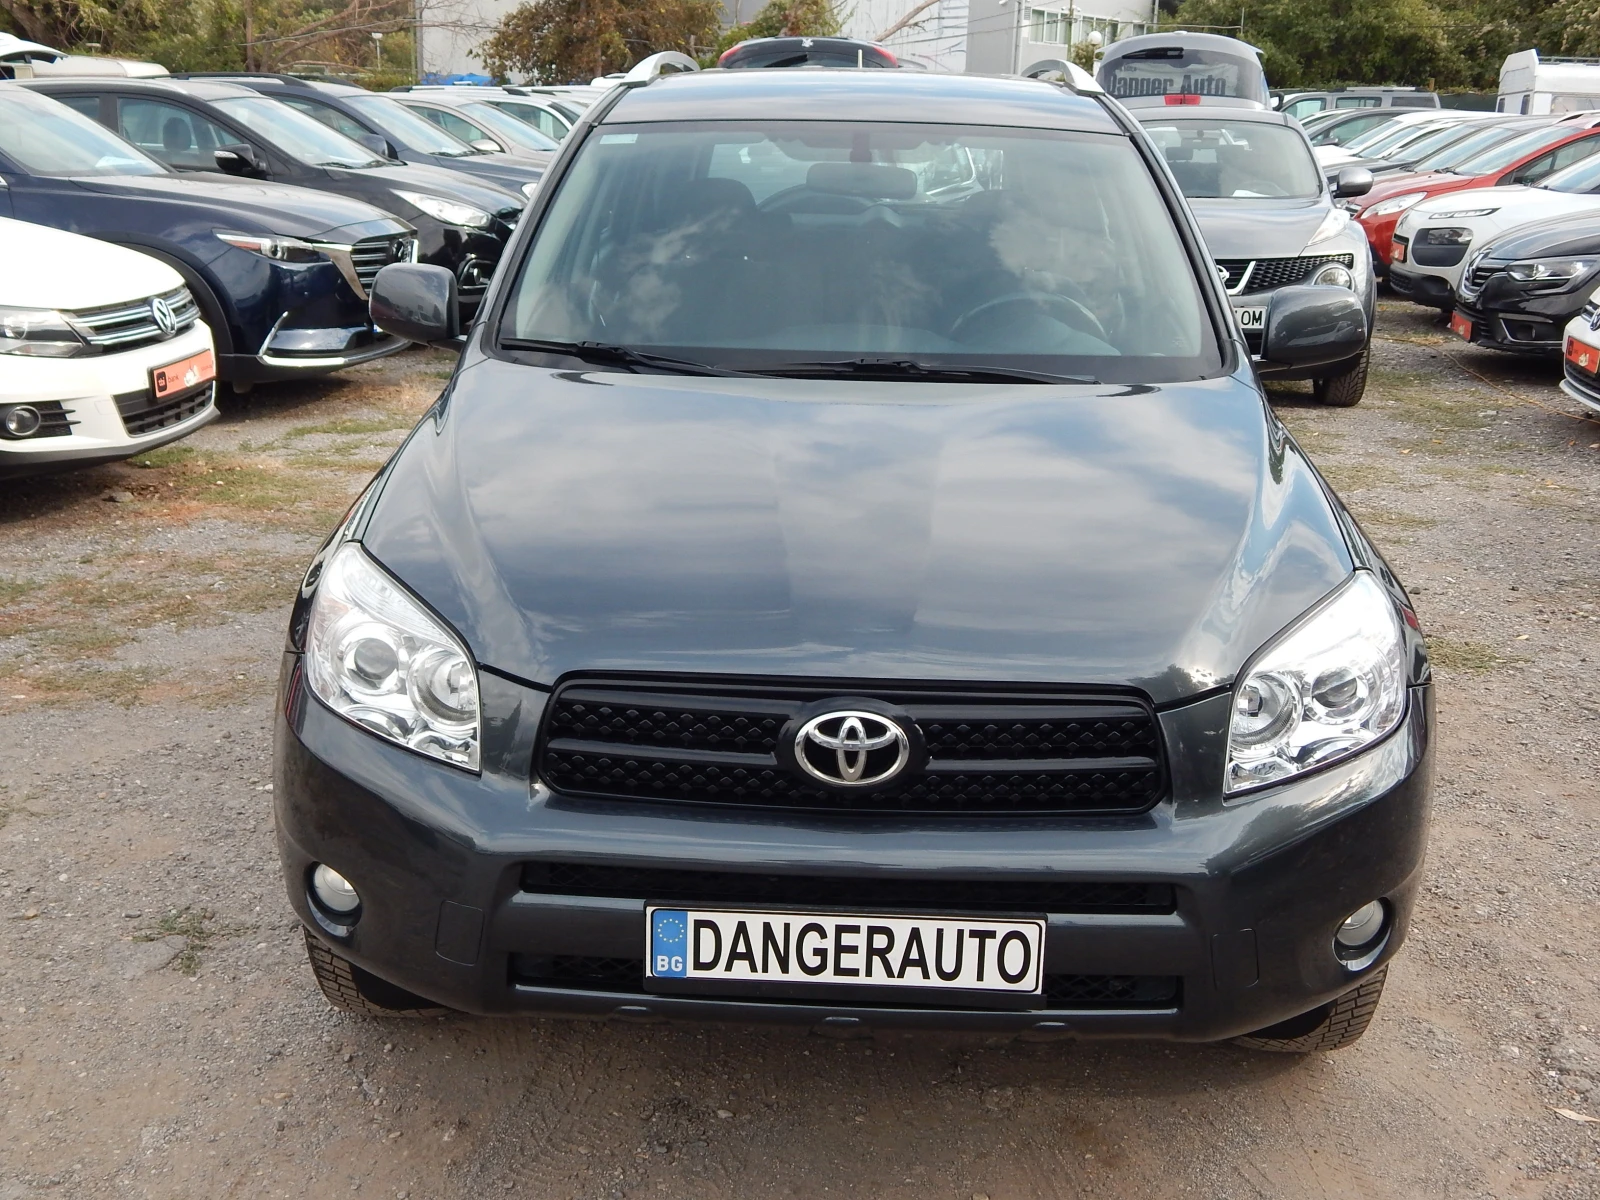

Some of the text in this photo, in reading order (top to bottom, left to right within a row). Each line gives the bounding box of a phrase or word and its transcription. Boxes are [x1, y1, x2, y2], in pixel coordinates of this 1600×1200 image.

[1235, 310, 1263, 326] OM
[692, 918, 1032, 984] DANGERAUTO
[656, 955, 683, 972] BG
